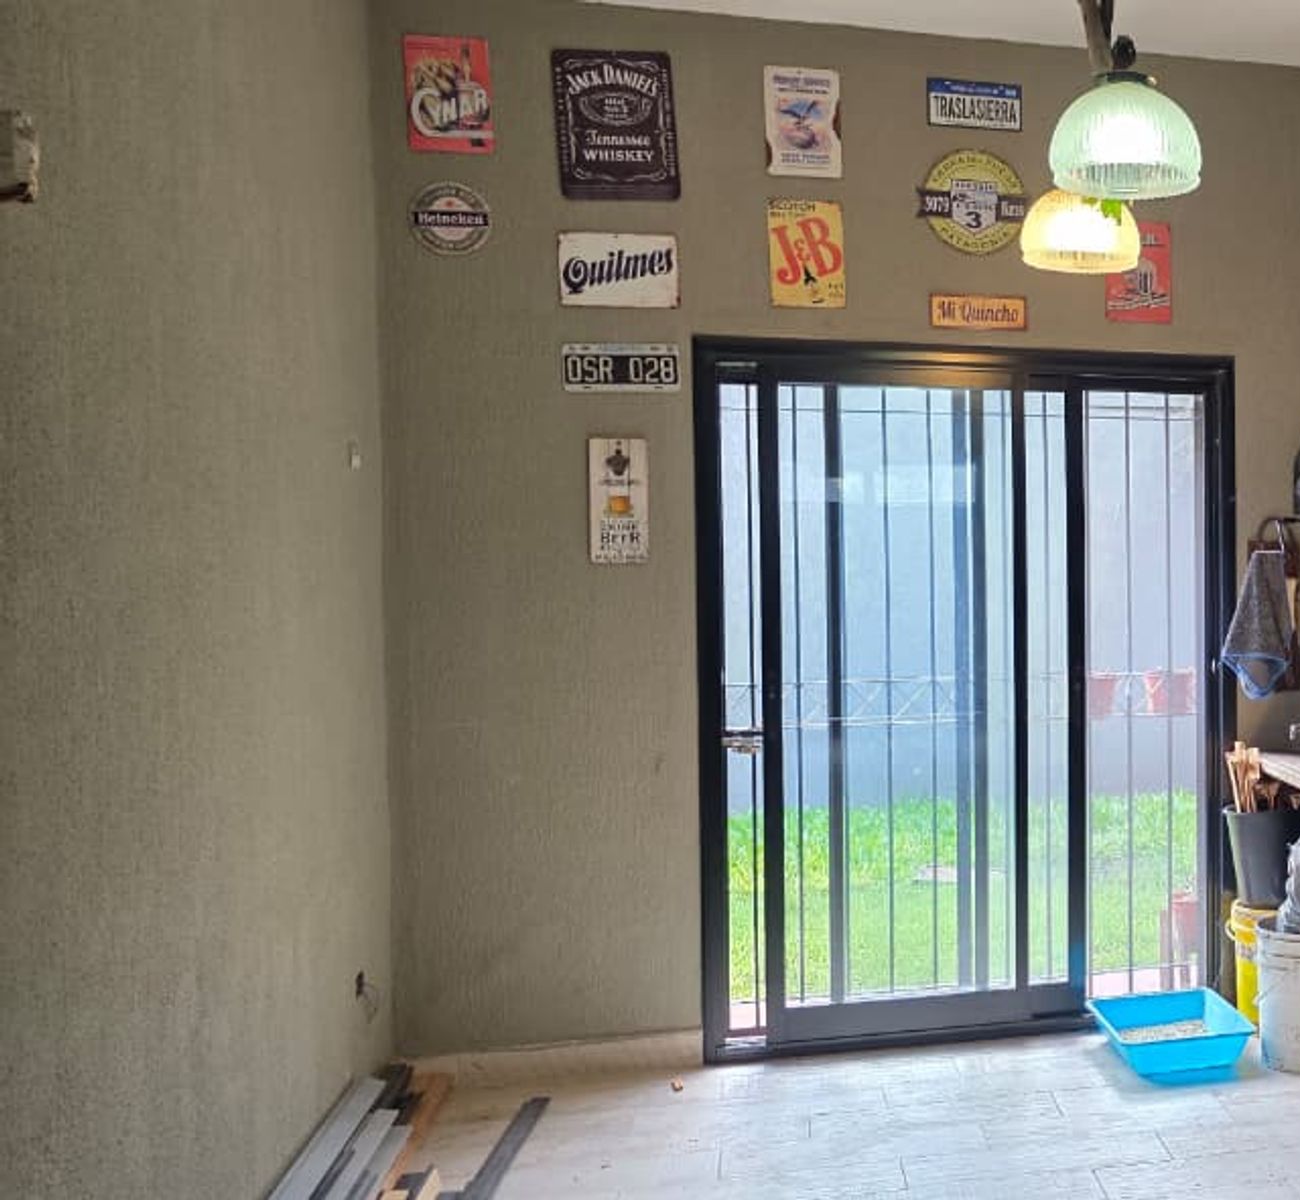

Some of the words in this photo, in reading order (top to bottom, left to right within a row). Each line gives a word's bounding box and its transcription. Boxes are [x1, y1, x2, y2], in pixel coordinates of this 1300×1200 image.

[566, 69, 602, 95] JACK
[603, 63, 660, 97] DANIEL'S
[934, 96, 1017, 123] TRASLASIERRA
[583, 150, 655, 163] WHISKEY
[418, 212, 486, 226] Heineken
[965, 211, 982, 229] 3
[771, 216, 843, 286] J&B
[562, 248, 673, 296] Quilmes
[936, 300, 956, 320] Mi
[961, 302, 1019, 323] Quincho
[628, 356, 676, 383] 028
